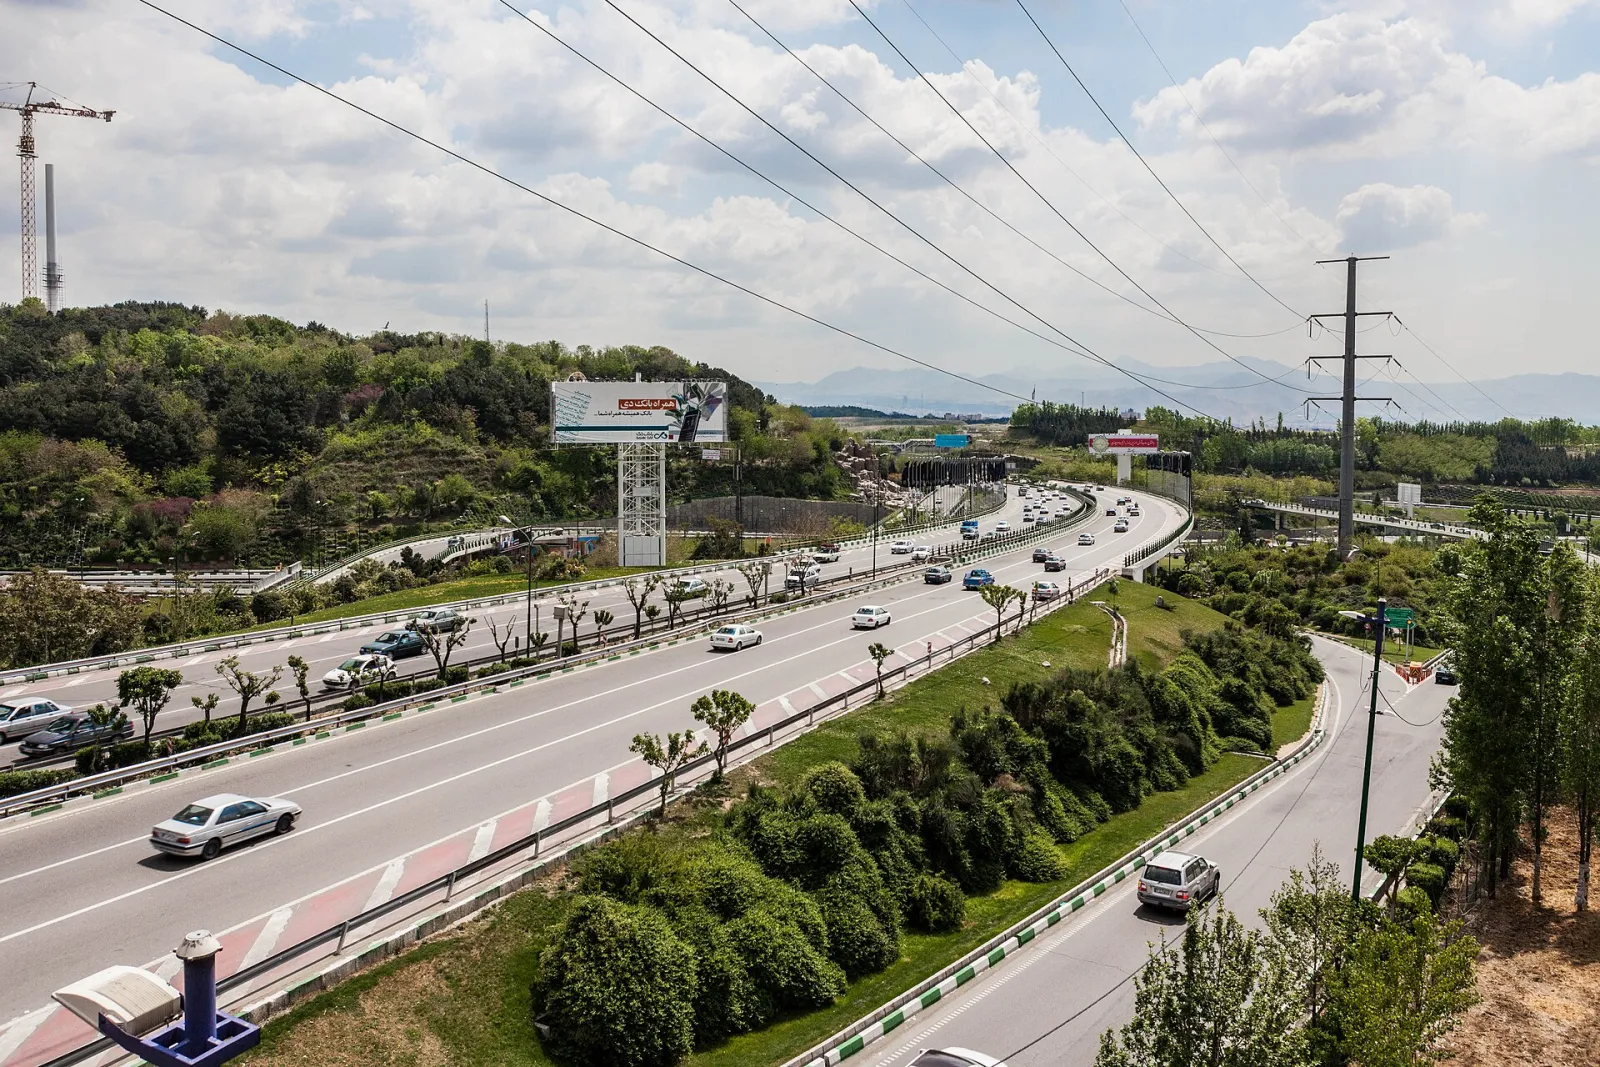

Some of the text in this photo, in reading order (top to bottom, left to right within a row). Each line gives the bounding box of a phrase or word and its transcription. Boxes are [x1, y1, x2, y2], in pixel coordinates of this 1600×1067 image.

[620, 399, 675, 410] همراه بانک دی
[608, 410, 621, 418] همراه
